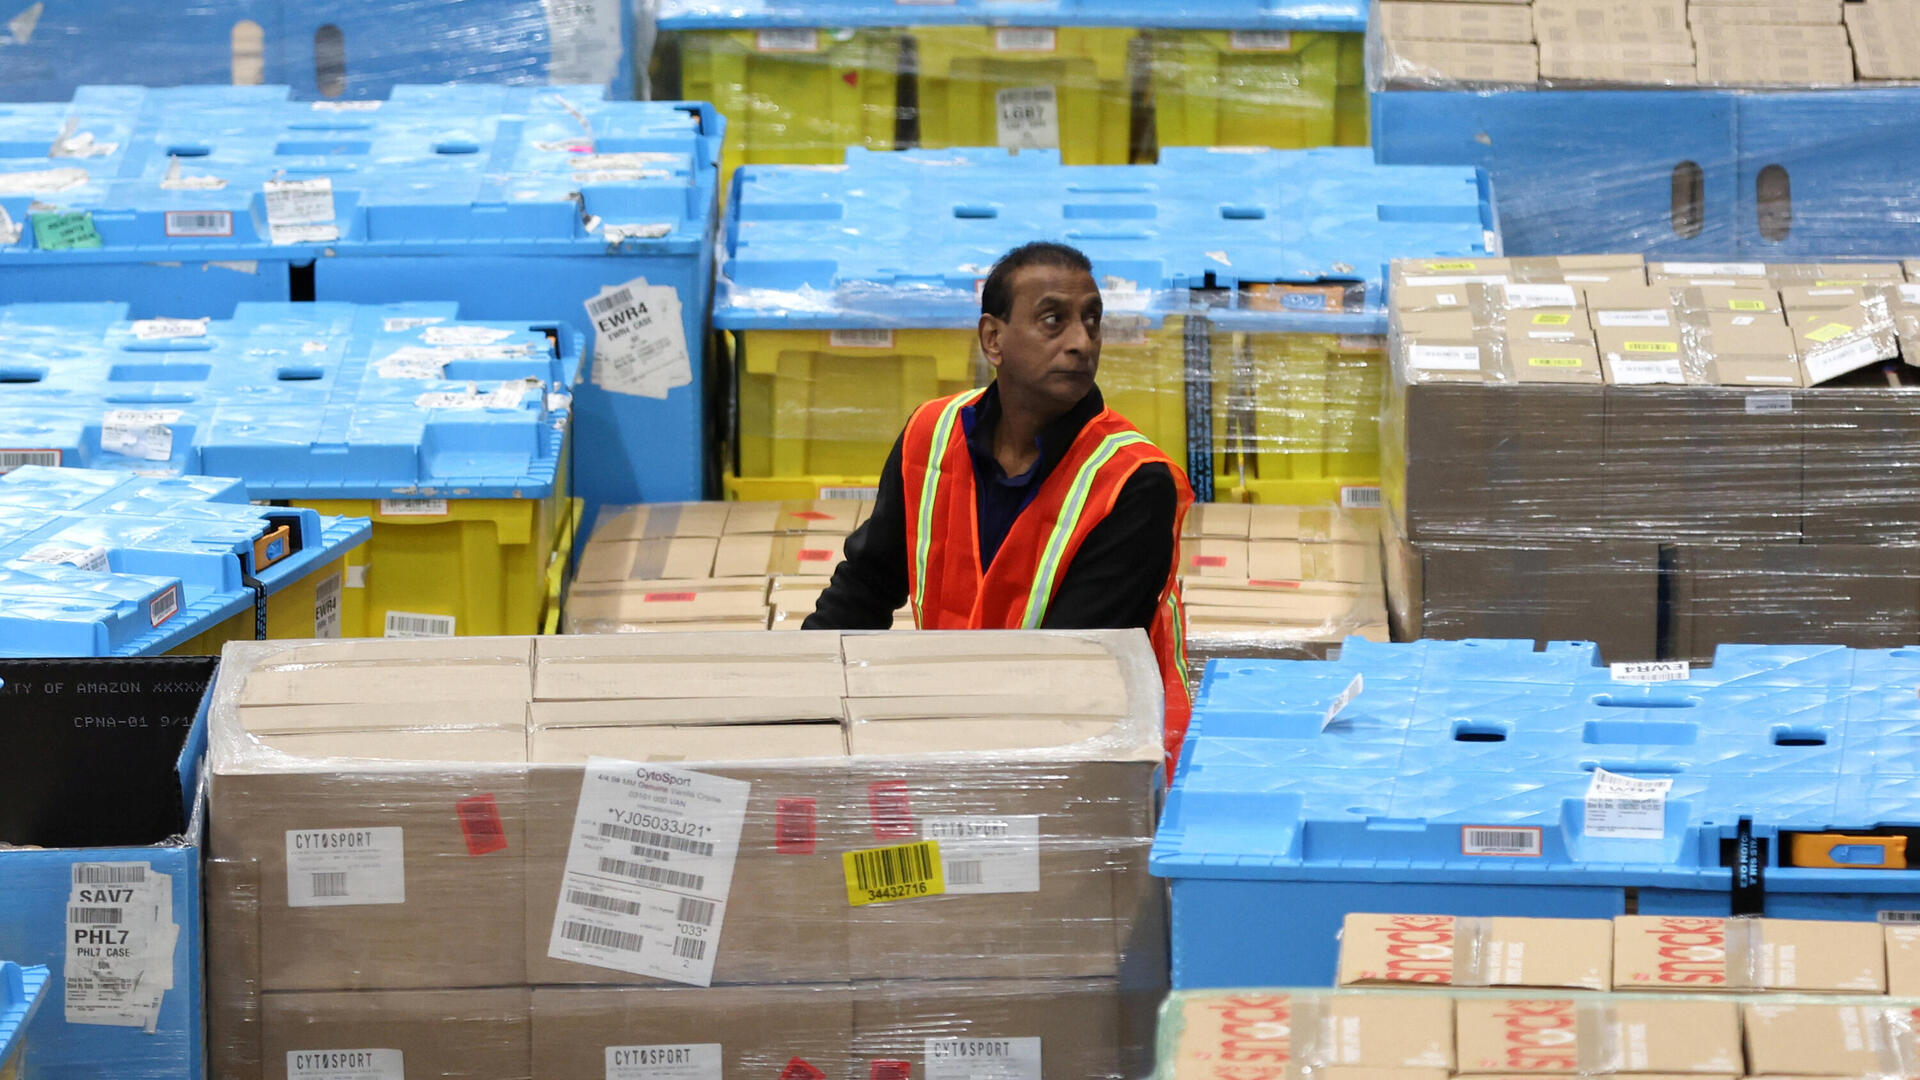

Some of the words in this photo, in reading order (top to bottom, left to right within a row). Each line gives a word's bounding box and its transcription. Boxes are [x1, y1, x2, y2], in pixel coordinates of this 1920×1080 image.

[598, 302, 649, 332] EWR4
[1625, 663, 1683, 673] EWR4
[44, 682, 64, 694] OF
[76, 682, 141, 694] AMAZON
[636, 767, 691, 787] CytoSport
[295, 832, 372, 849] CYTOSPORT
[79, 889, 134, 903] SAV7
[868, 882, 927, 901] 34432716
[75, 929, 130, 945] PHL7
[77, 947, 101, 957] PHL7
[106, 947, 130, 958] CASE
[1645, 924, 1725, 984] snack
[1492, 1006, 1577, 1070] snack
[296, 1053, 372, 1070] CYTOSPORT
[615, 1048, 691, 1066] CYTOSPORT
